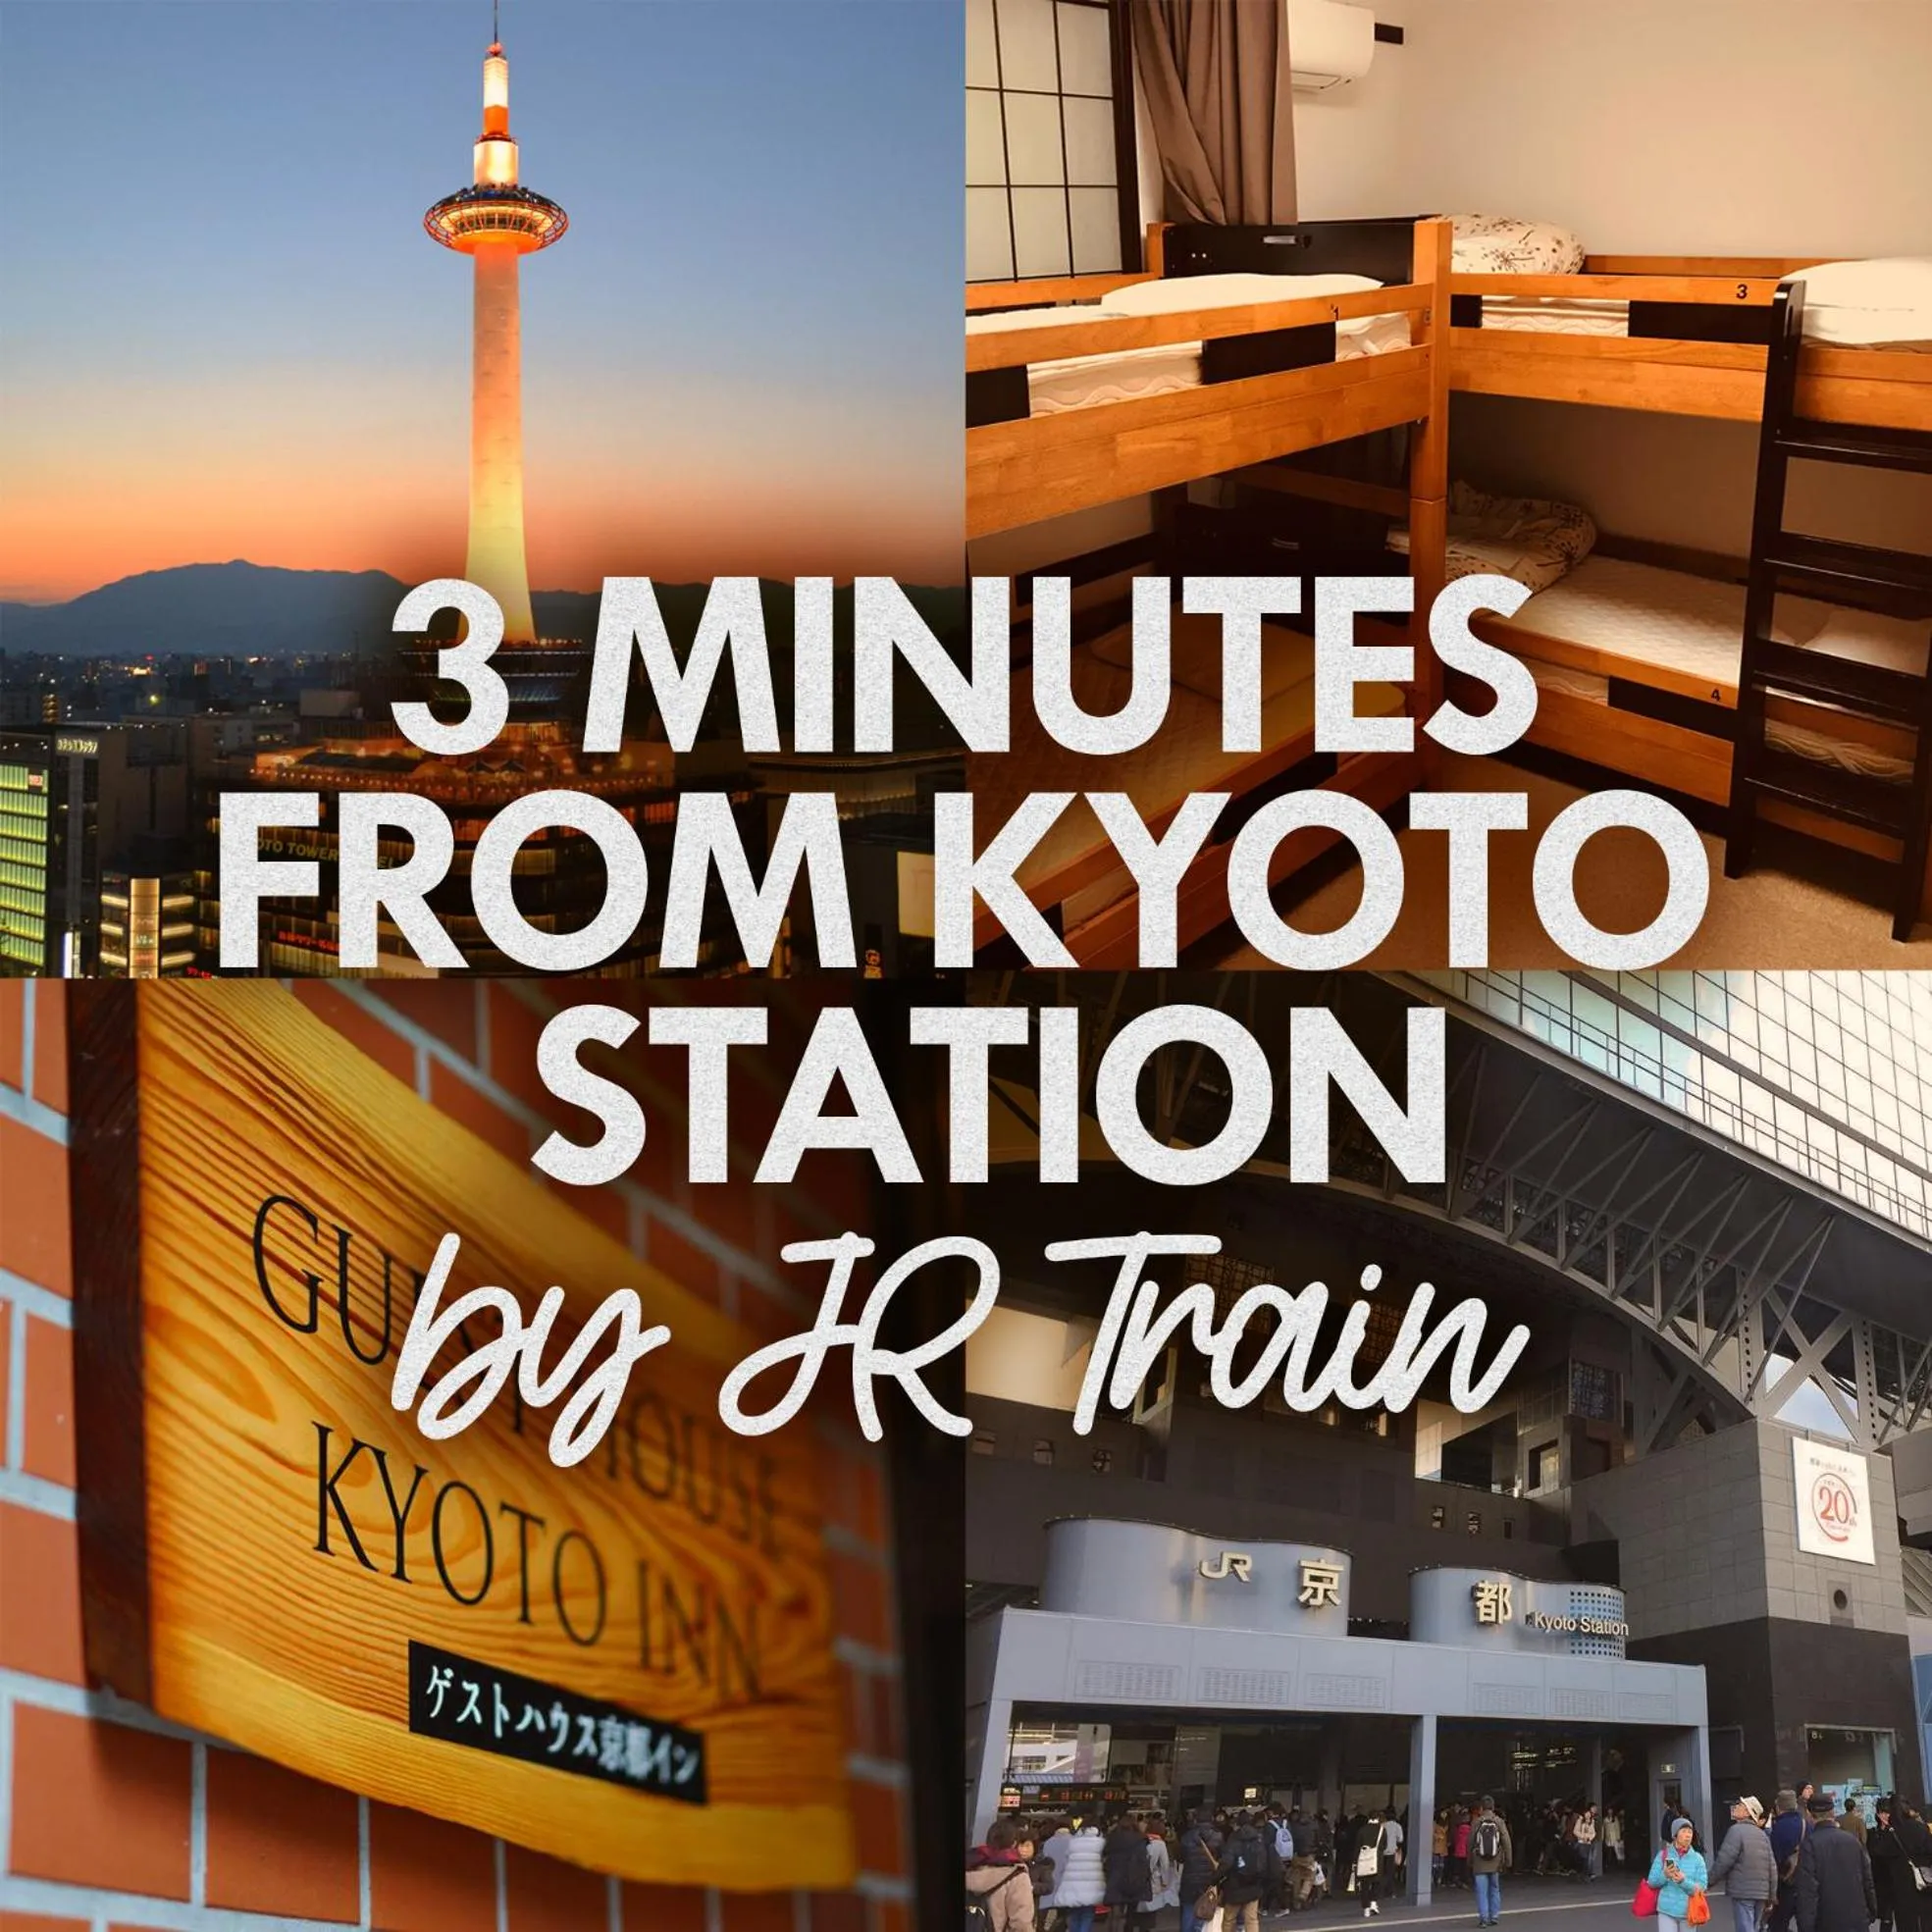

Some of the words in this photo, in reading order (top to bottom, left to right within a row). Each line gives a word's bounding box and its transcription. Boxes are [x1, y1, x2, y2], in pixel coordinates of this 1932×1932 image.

[1736, 284, 1749, 299] 3
[311, 1420, 606, 1647] KYOTO
[637, 1558, 760, 1702] INN
[1200, 1551, 1253, 1583] JR
[1297, 1558, 1344, 1607] 京
[1473, 1581, 1512, 1625] 都
[1533, 1611, 1577, 1633] Kyoto
[1579, 1615, 1630, 1637] Station
